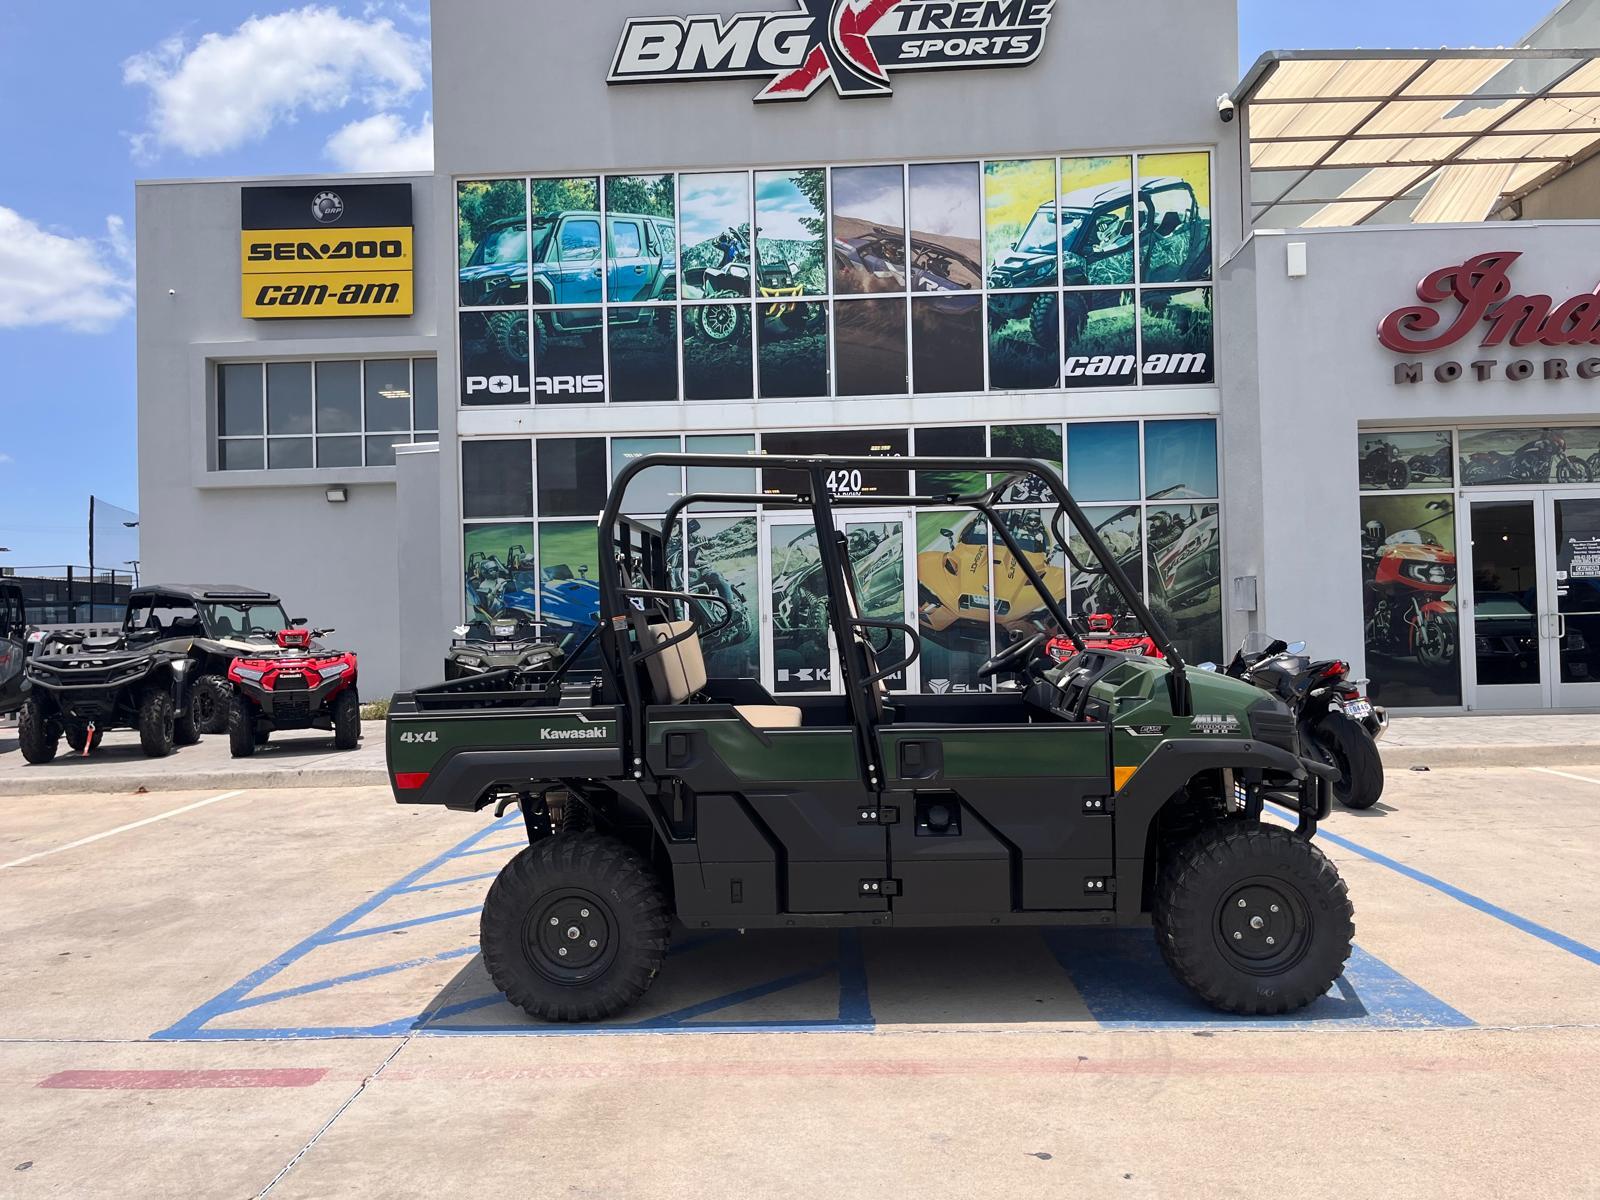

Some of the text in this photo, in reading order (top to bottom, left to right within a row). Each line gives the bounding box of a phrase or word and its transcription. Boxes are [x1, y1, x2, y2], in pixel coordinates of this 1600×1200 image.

[617, 17, 816, 73] BMG
[898, 35, 1033, 59] SPORTS
[1064, 352, 1206, 376] canam
[1394, 357, 1600, 385] MOTORC
[466, 374, 605, 396] POLARIS
[825, 469, 862, 492] 420
[400, 731, 439, 743] 4x4
[540, 726, 607, 740] Kawasaki
